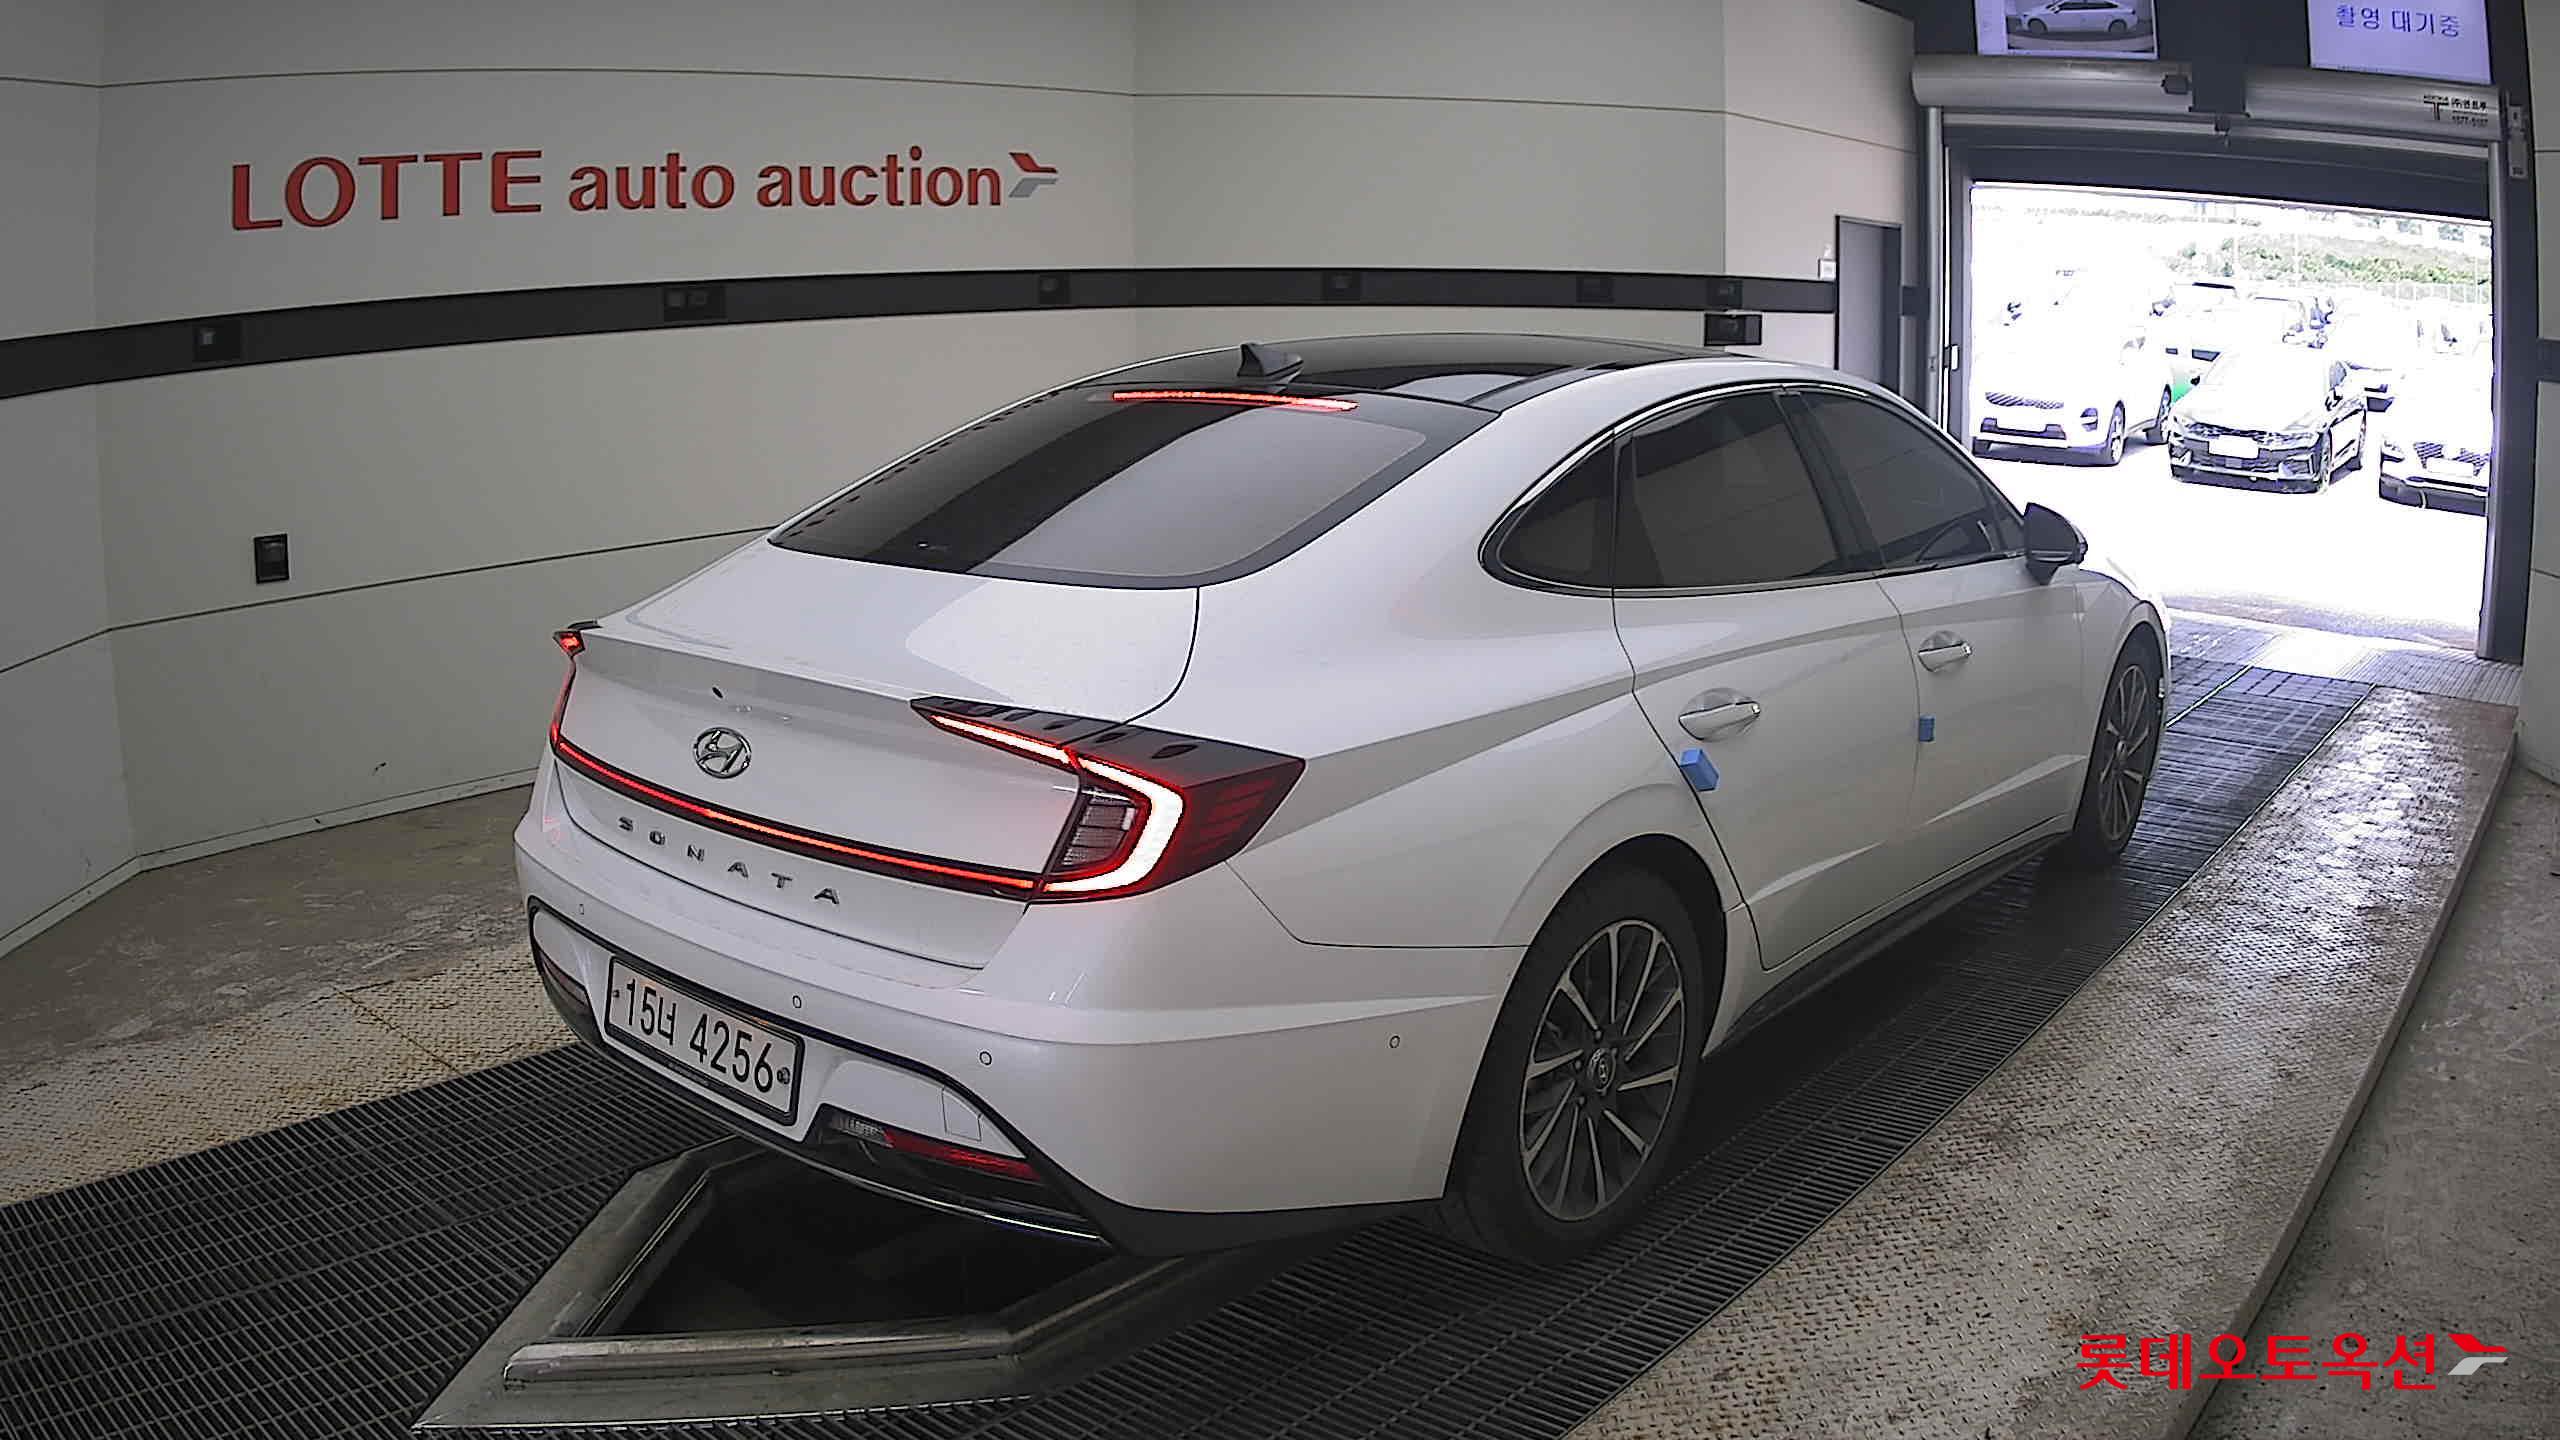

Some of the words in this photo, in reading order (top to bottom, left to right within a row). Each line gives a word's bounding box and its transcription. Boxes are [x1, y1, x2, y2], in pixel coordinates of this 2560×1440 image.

[2336, 4, 2380, 30] 촬영
[2391, 9, 2460, 38] 대기중
[232, 150, 543, 231] LOTTE
[568, 152, 736, 210] auto
[756, 144, 1002, 208] auction
[618, 816, 840, 905] SONATA
[626, 977, 677, 1046] 15너
[689, 1013, 774, 1093] 4256
